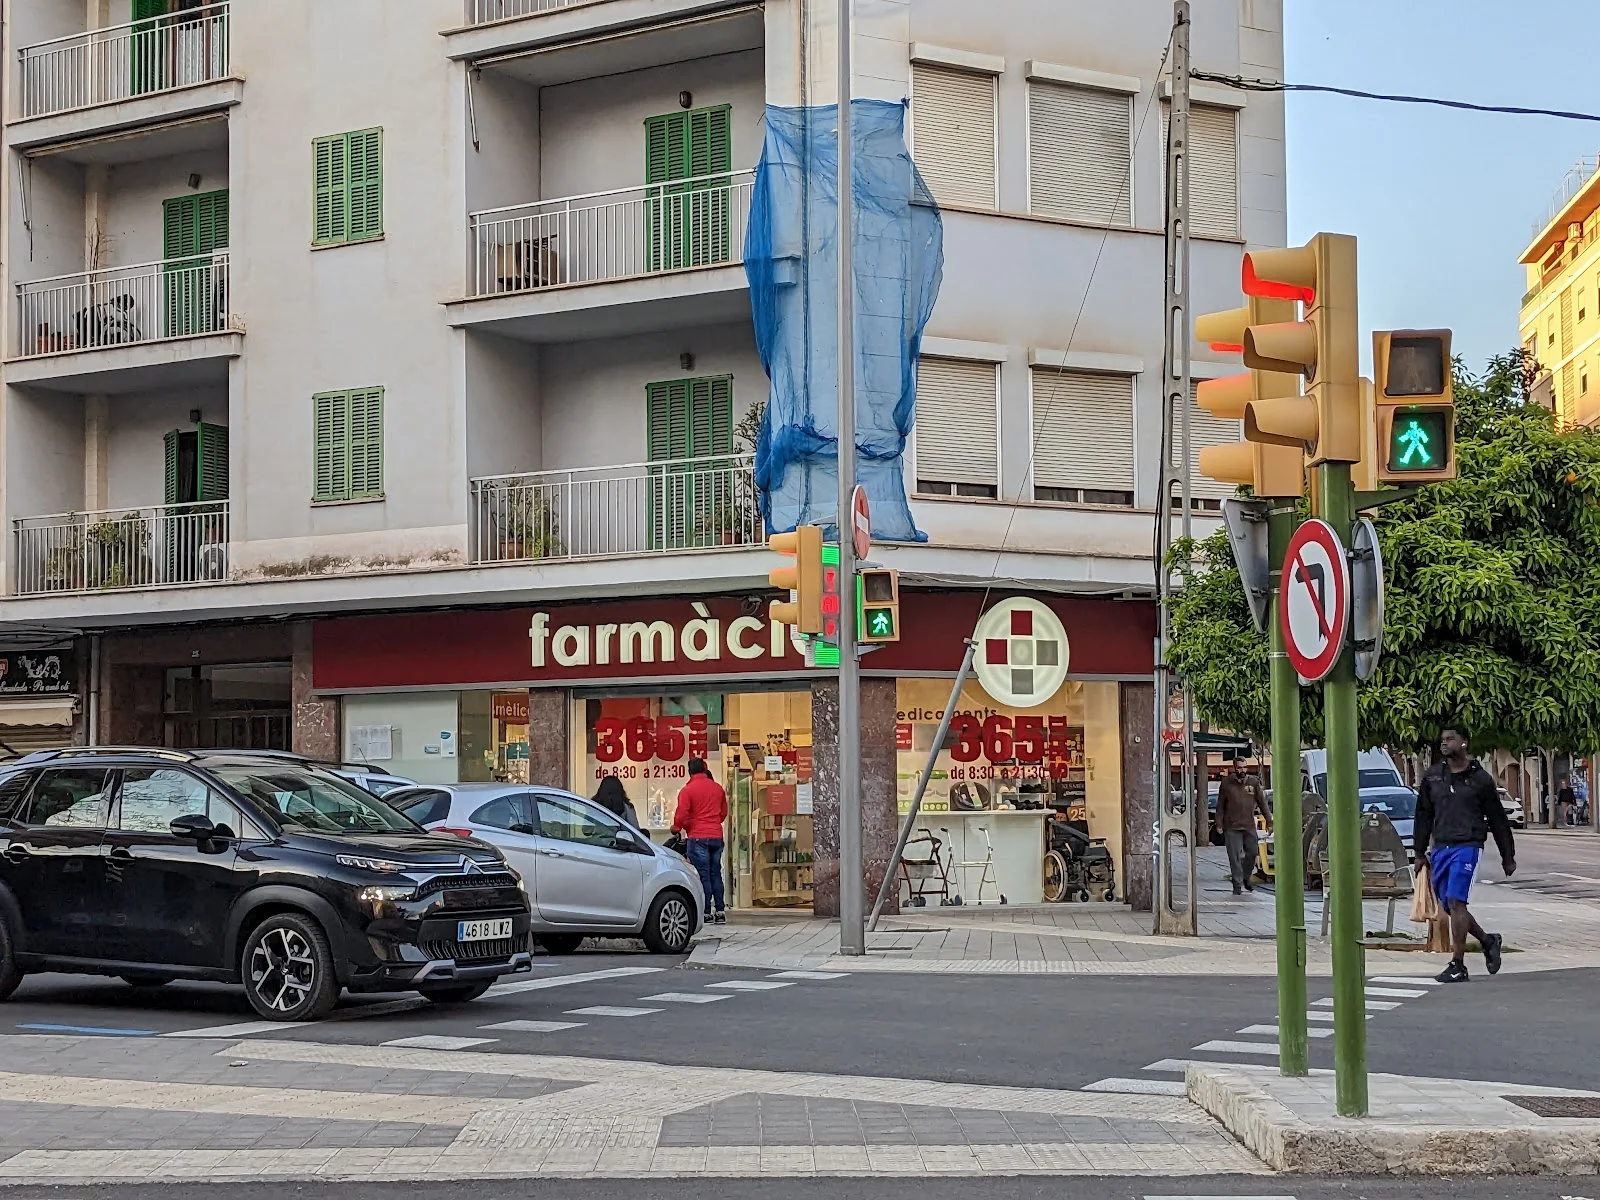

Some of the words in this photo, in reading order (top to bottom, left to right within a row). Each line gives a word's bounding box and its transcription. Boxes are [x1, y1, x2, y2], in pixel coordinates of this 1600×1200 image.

[493, 701, 530, 718] mètic
[594, 715, 685, 763] 365
[950, 714, 1045, 763] 365
[643, 767, 650, 779] a
[653, 764, 686, 778] 21:30
[950, 766, 965, 780] de
[968, 766, 995, 779] 8:30
[1001, 768, 1009, 779] a
[1013, 765, 1046, 779] 21:30
[465, 922, 490, 938] 4618
